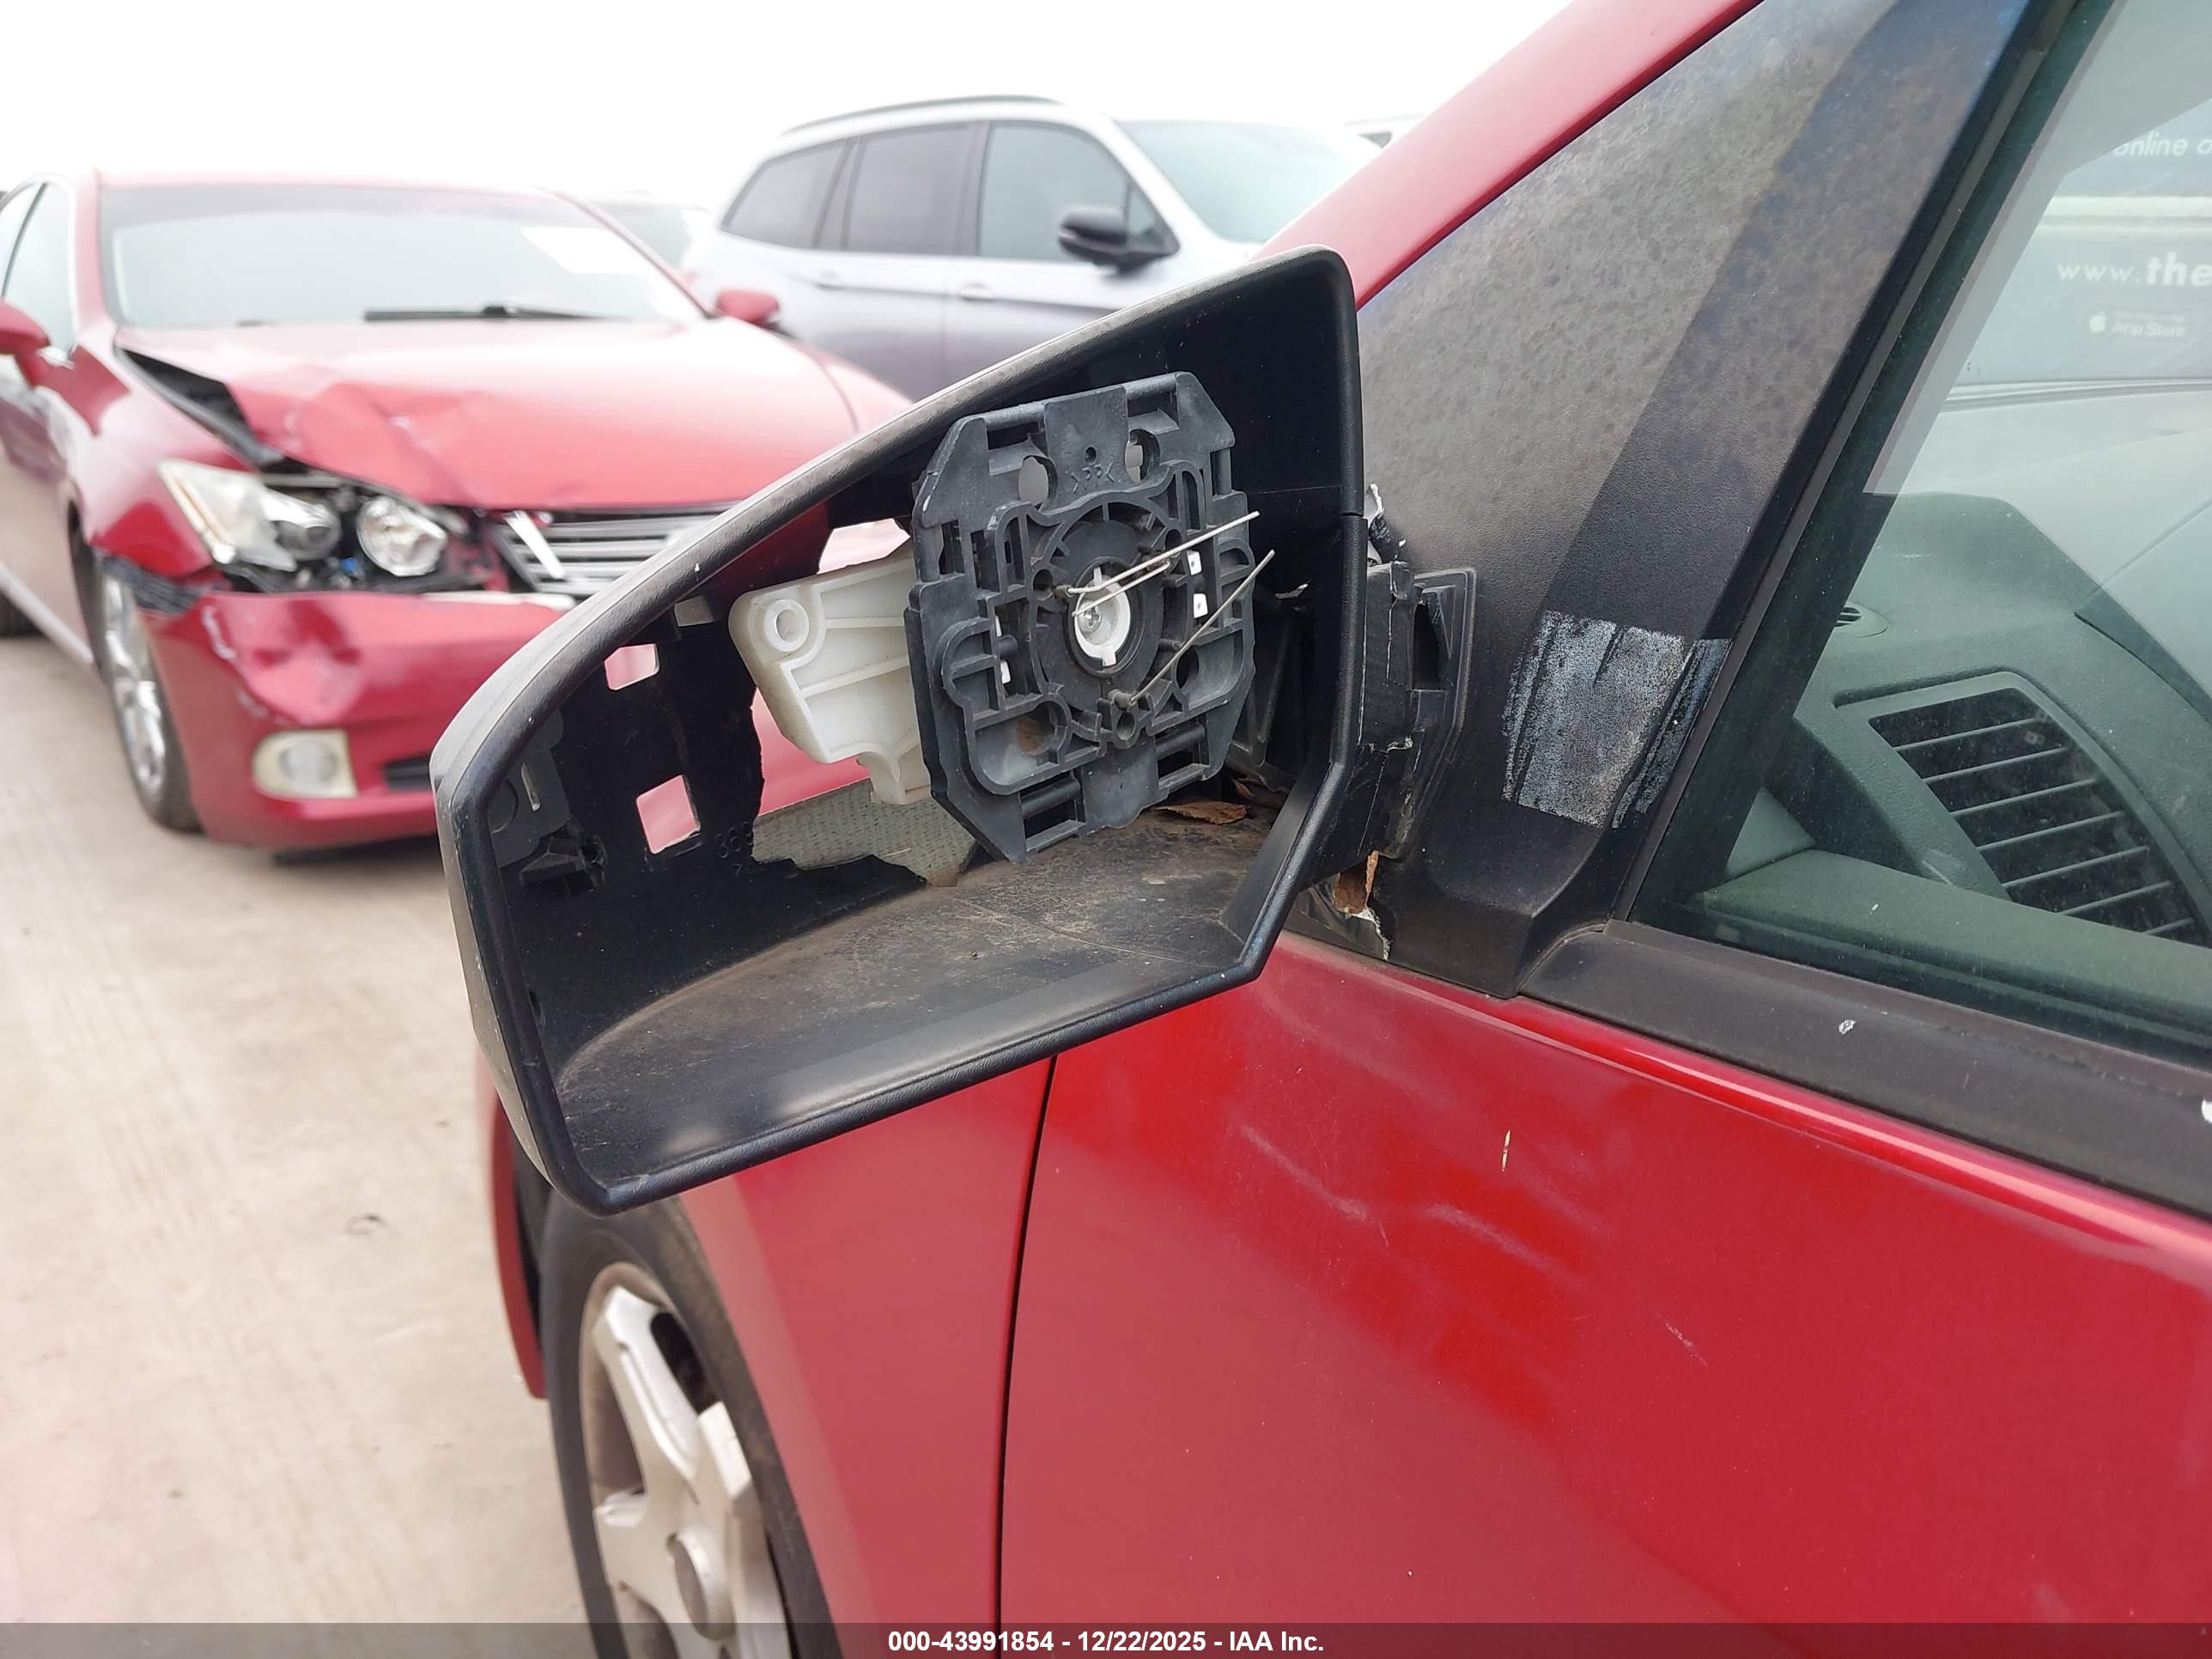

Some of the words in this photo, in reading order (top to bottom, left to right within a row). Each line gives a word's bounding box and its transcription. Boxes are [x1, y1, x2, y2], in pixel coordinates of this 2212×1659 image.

[2113, 131, 2188, 156] online
[2057, 252, 2212, 287] www.the
[2112, 321, 2144, 337] App
[2145, 320, 2186, 337] Store
